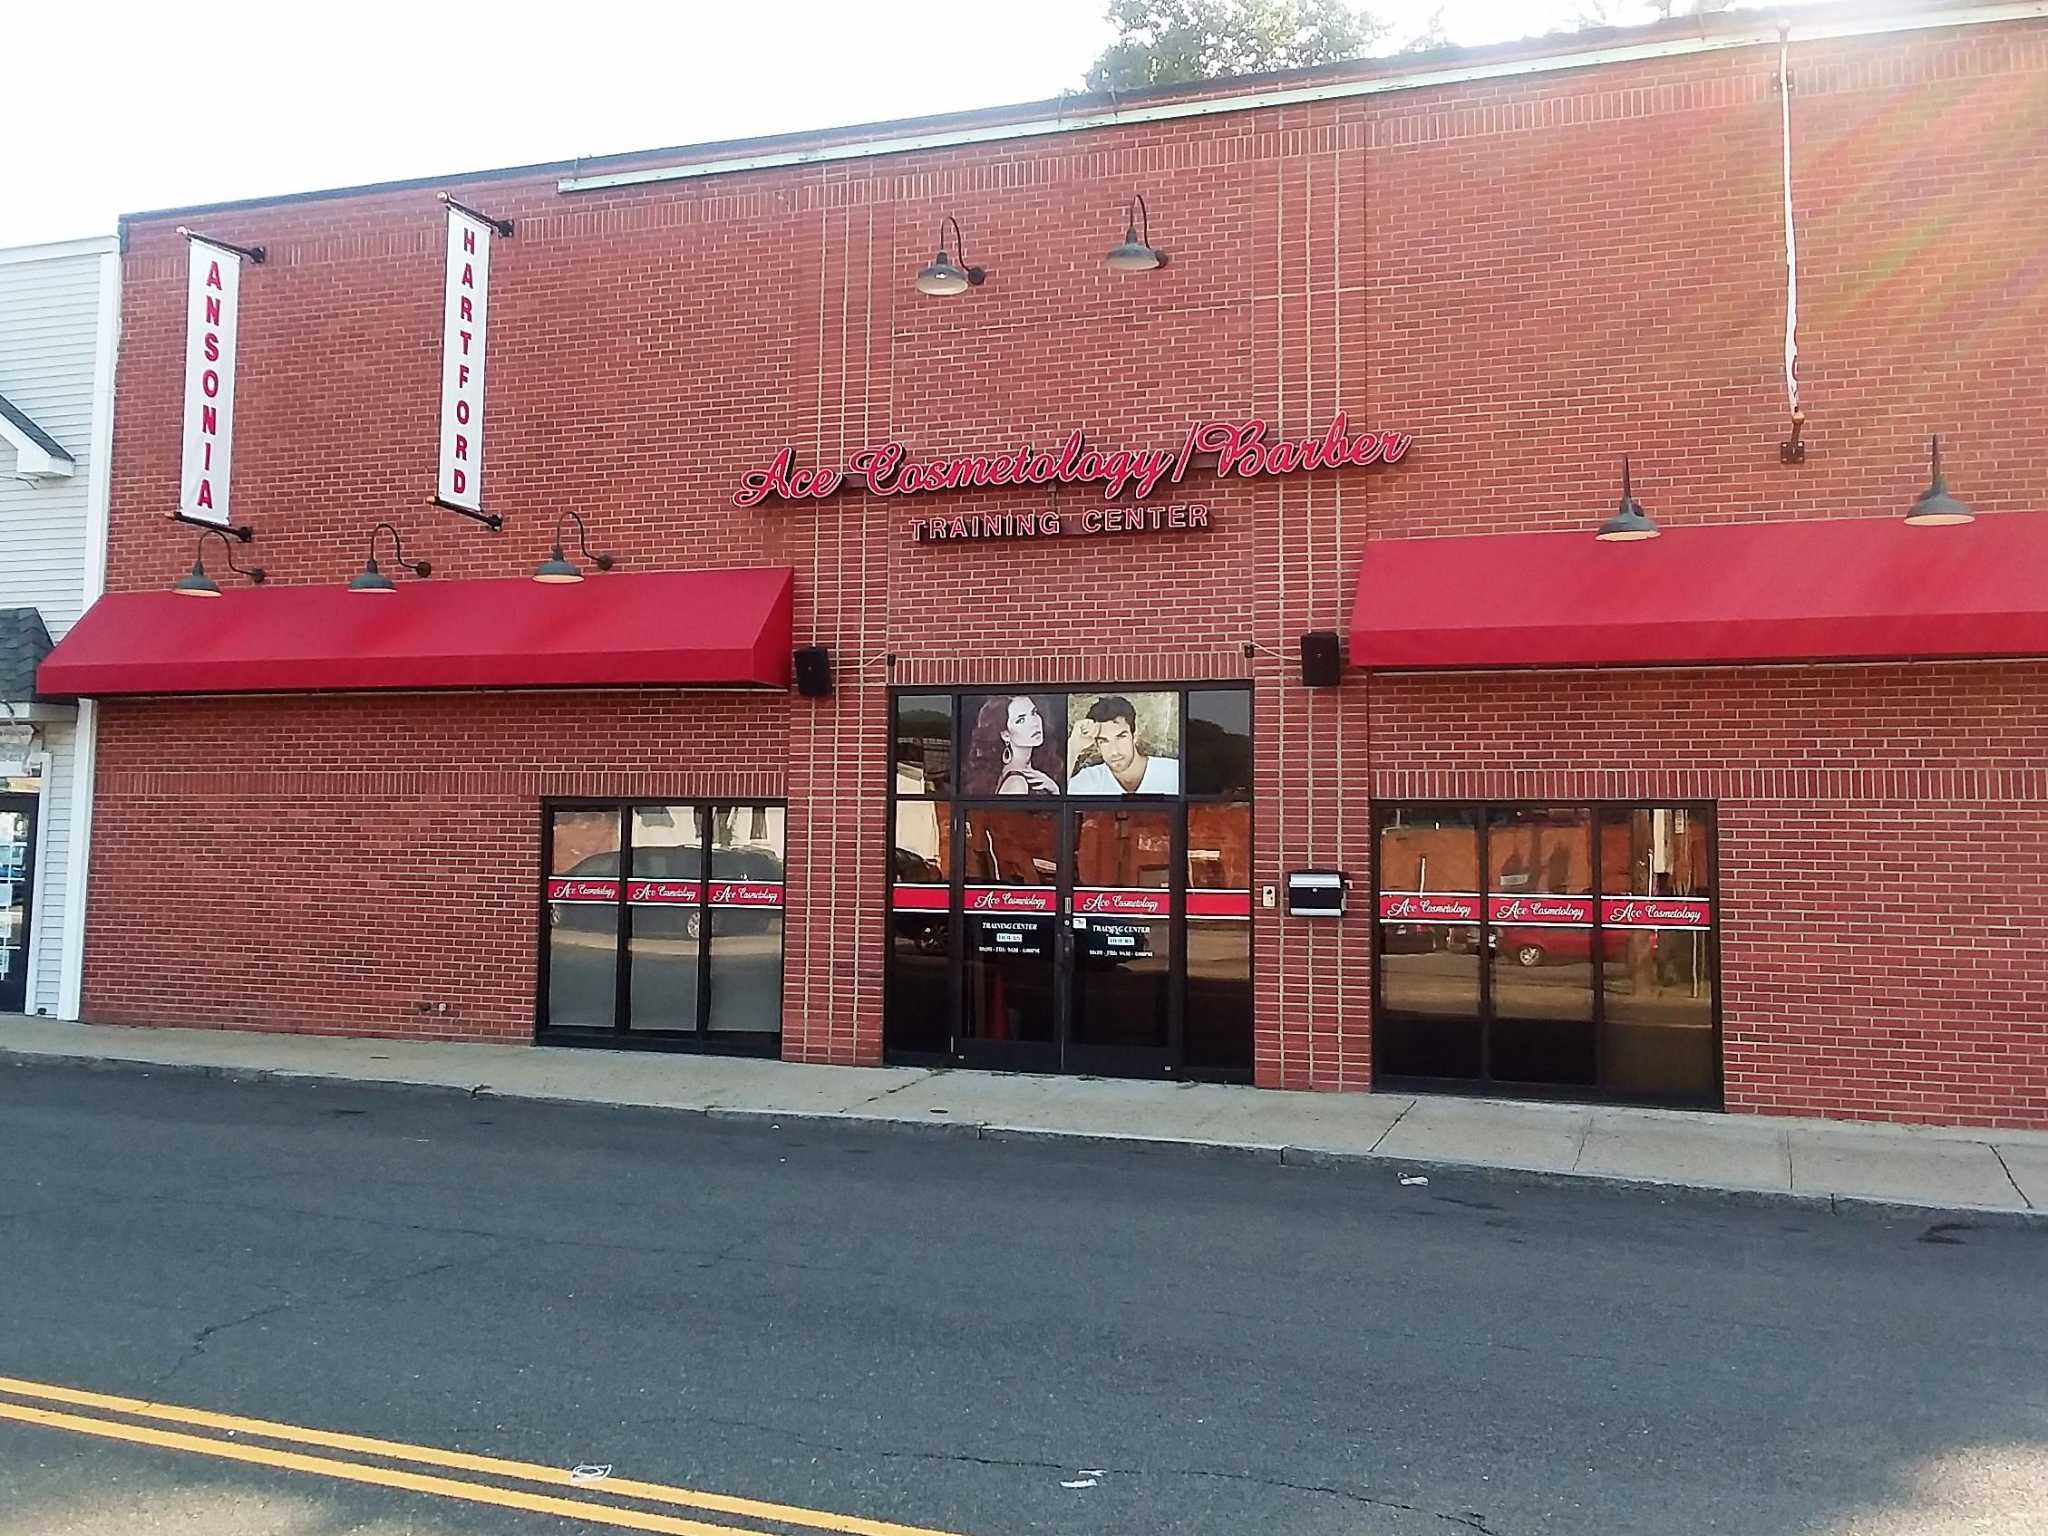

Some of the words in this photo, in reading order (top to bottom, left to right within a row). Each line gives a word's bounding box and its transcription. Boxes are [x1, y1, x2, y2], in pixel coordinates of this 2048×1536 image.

[453, 226, 476, 495] HARTFORD
[196, 260, 223, 510] ANSONIA
[733, 447, 843, 508] Ace
[908, 510, 1061, 543] TRAINING
[1081, 504, 1209, 534] CENTER
[553, 882, 576, 898] Ace
[632, 883, 657, 900] Ace
[712, 885, 736, 902] Ace
[973, 890, 1001, 909] Ace
[1083, 893, 1110, 912] Ace
[1386, 898, 1418, 917] Ace
[1496, 901, 1528, 920] Ace
[1609, 902, 1643, 923] Ace
[982, 921, 1011, 931] TRAINING
[1012, 922, 1038, 931] CENTER
[1092, 924, 1124, 934] TRAINING
[1124, 925, 1151, 934] CENTER
